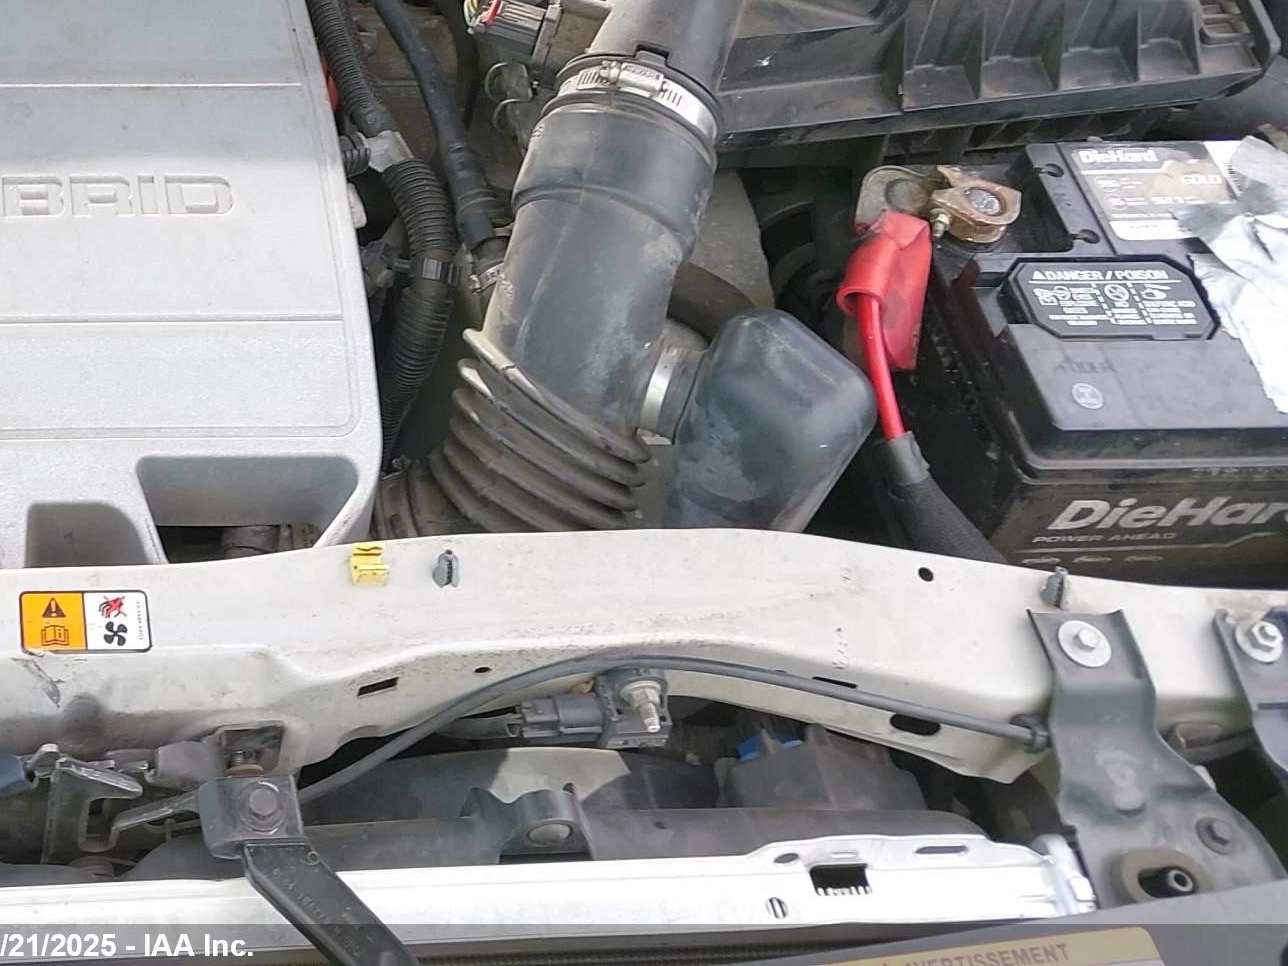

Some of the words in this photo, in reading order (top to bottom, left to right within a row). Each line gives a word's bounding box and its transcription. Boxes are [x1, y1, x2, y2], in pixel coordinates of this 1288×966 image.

[1078, 149, 1159, 163] DieHard
[1181, 173, 1222, 185] GOLD
[1047, 270, 1104, 281] DANGER
[1118, 270, 1169, 280] POISON
[1047, 496, 1288, 530] DieHar
[1032, 535, 1104, 543] POWER
[1108, 532, 1177, 542] AHEAD
